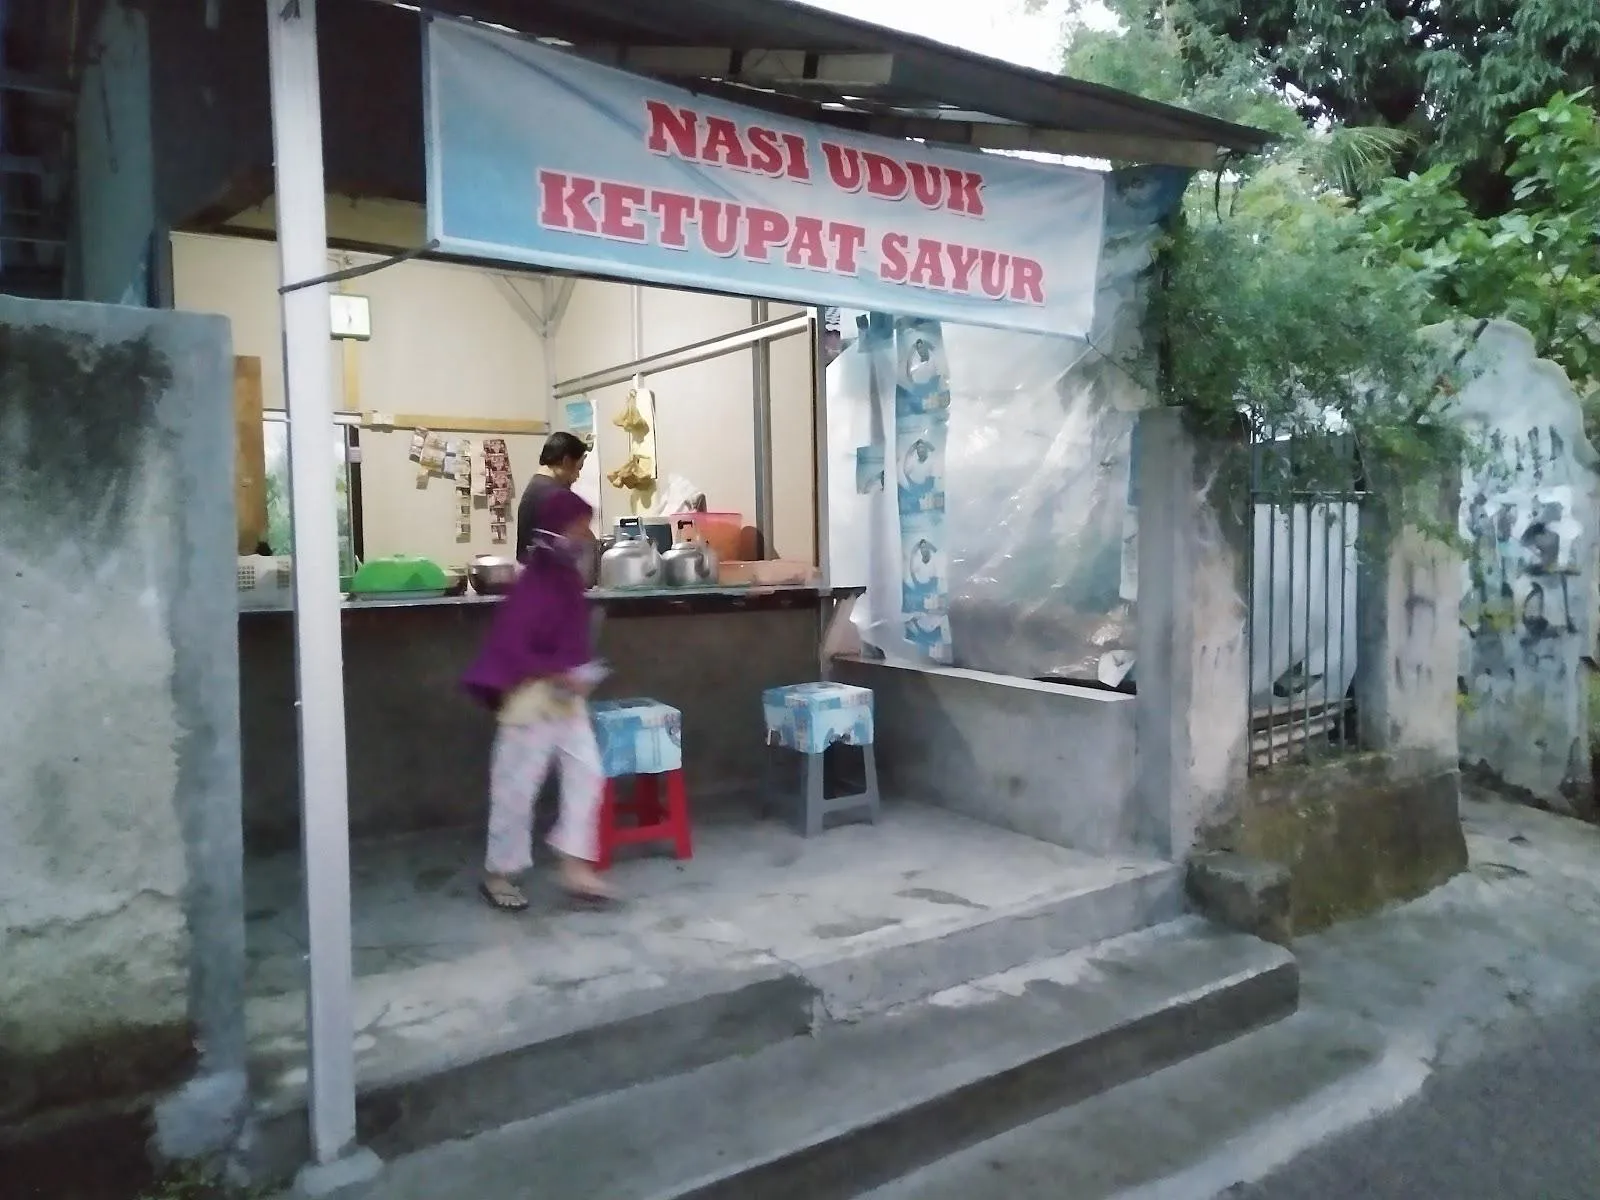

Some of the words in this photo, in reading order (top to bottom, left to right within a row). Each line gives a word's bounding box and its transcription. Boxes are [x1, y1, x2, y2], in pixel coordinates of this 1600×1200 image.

[647, 101, 809, 181] NASI
[822, 142, 985, 216] UDUK
[540, 171, 865, 274] KETUPAT
[880, 232, 1044, 303] SAYUR
